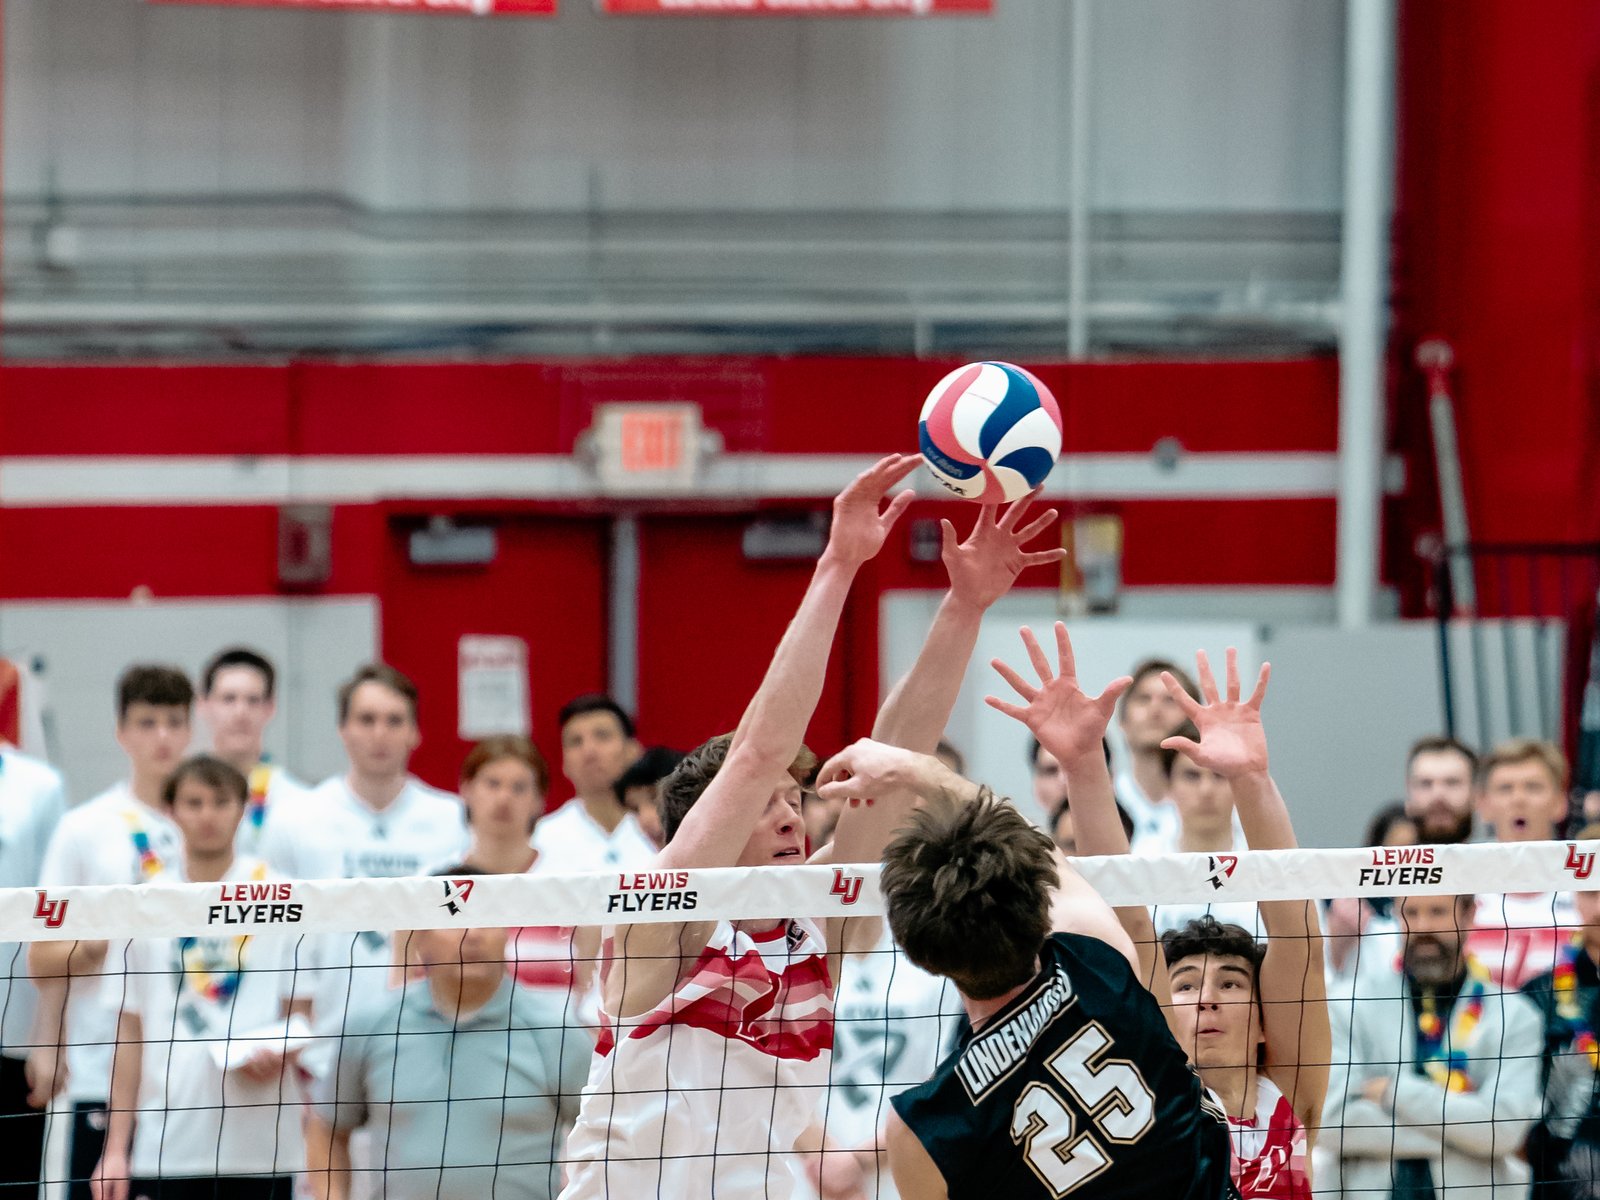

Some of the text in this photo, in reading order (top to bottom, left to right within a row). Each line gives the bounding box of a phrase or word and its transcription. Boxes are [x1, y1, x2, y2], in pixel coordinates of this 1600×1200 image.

[1372, 848, 1434, 866] LEWIS
[1564, 843, 1595, 879] LU
[619, 872, 689, 890] LEWIS
[830, 868, 864, 905] LU
[1359, 867, 1443, 886] FLYERS
[220, 884, 292, 902] LEWIS
[607, 891, 697, 913] FLYERS
[33, 890, 69, 929] LU
[208, 904, 303, 924] FLYERS
[1010, 1019, 1156, 1200] 25
